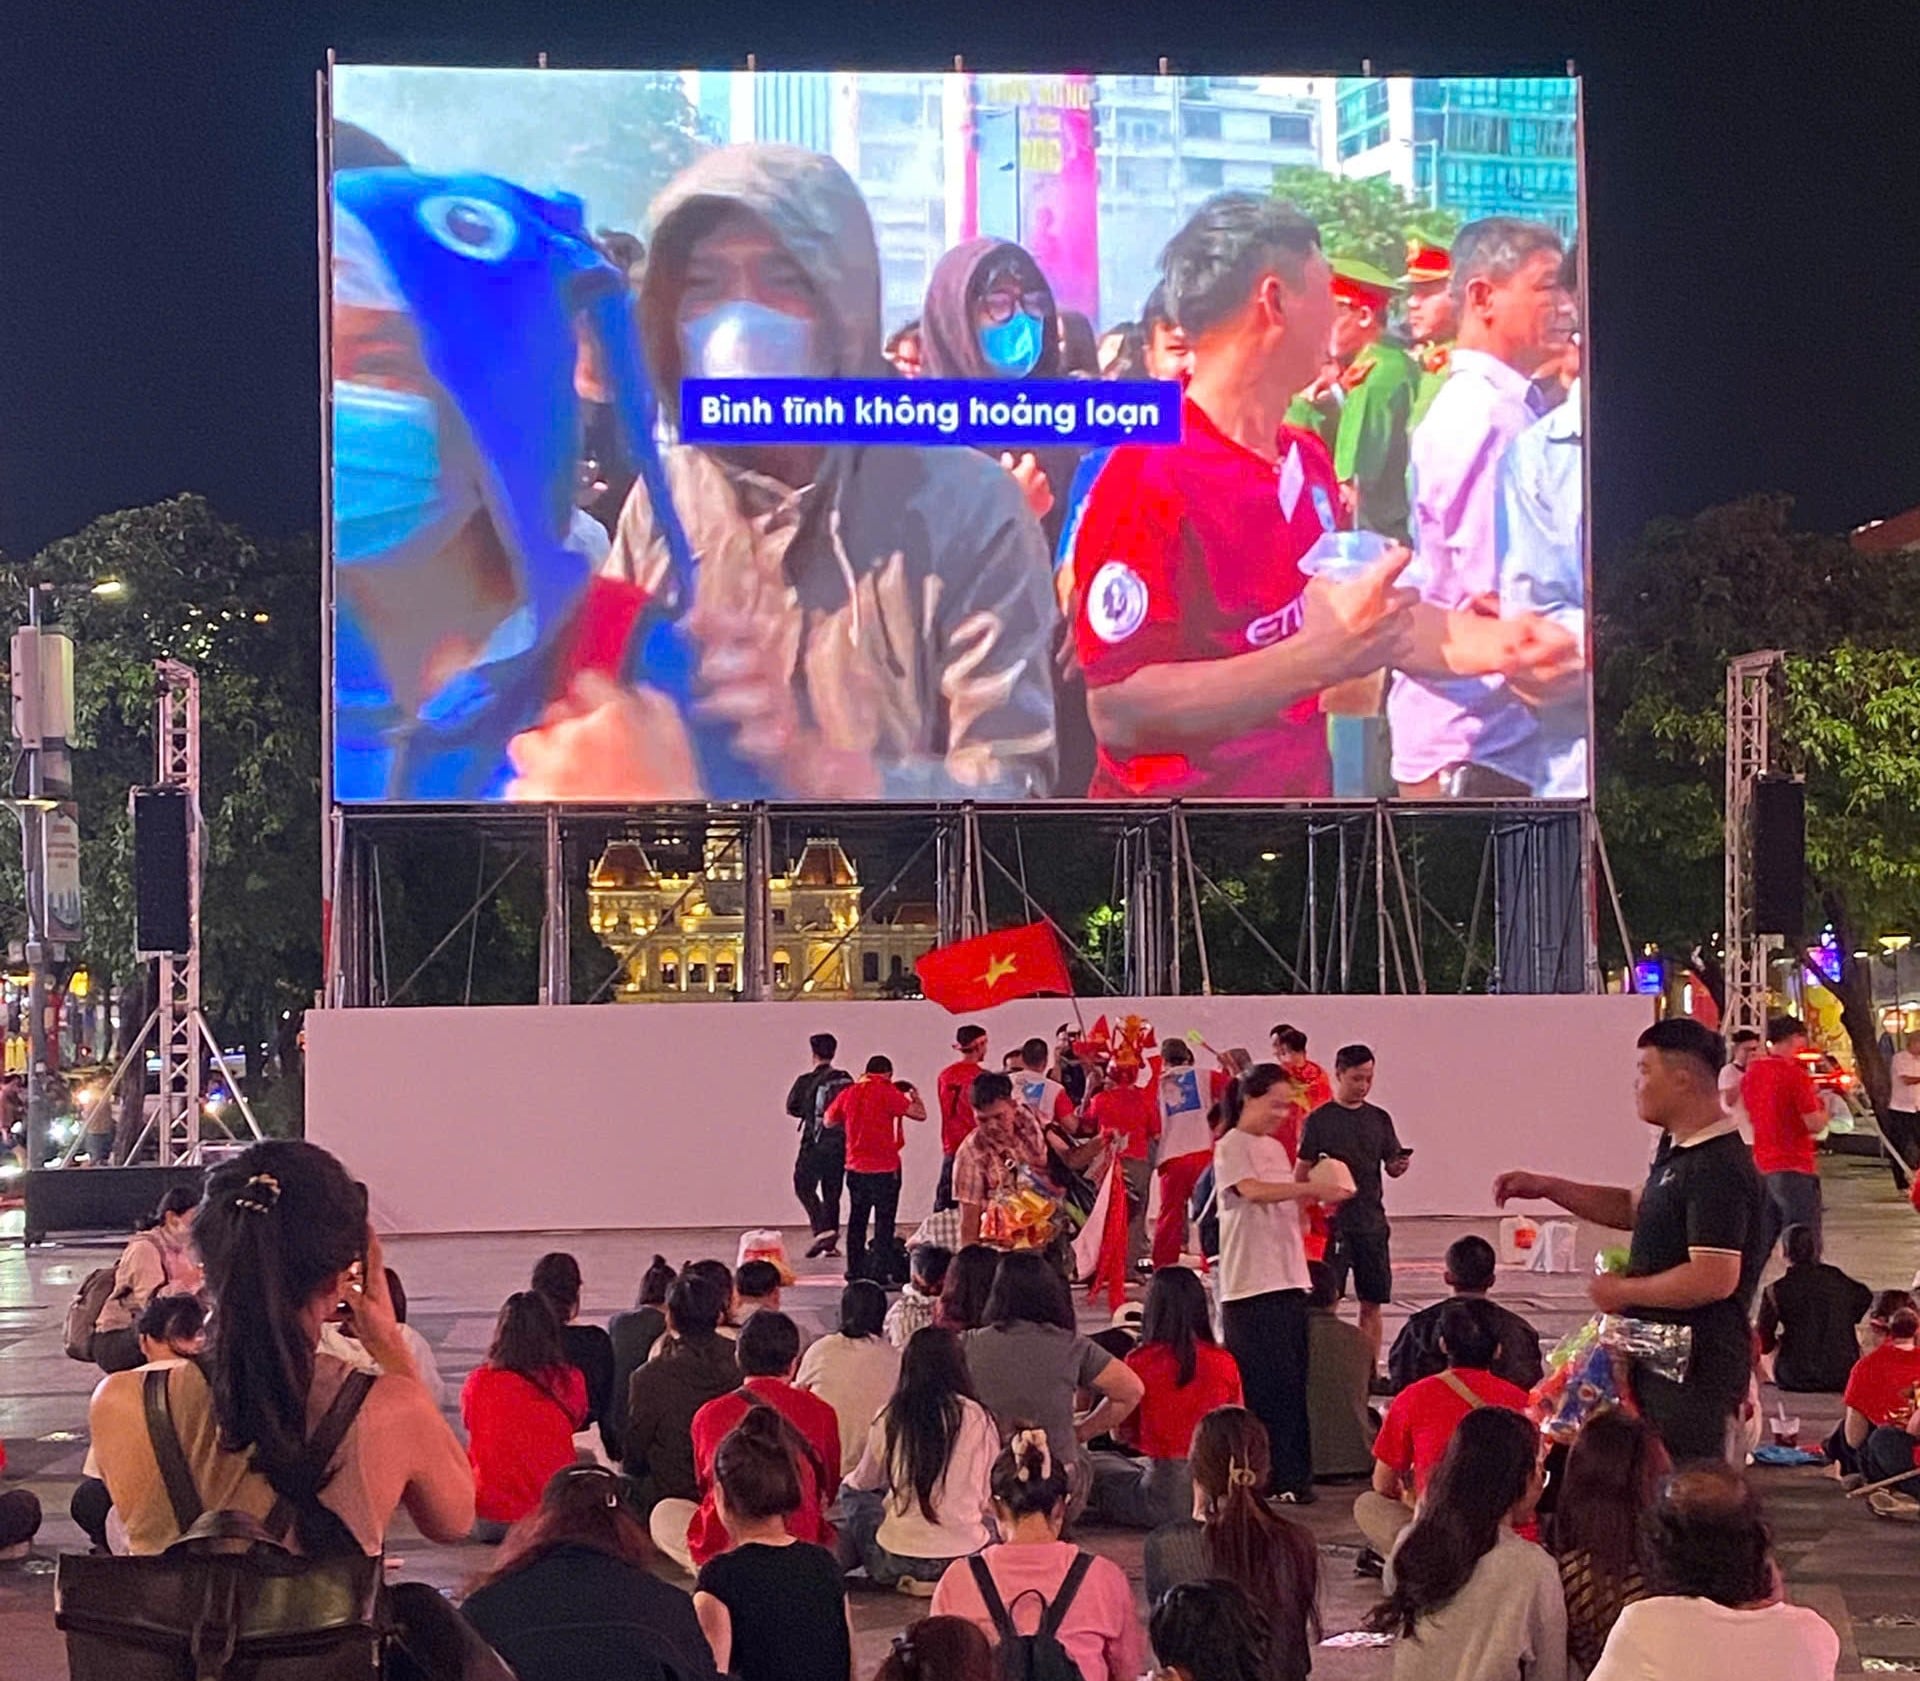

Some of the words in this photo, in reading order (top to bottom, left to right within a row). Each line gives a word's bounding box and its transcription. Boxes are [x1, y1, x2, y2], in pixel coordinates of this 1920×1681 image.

[700, 394, 773, 425] Bình
[782, 396, 845, 425] tĩnh
[855, 395, 960, 433] không
[969, 392, 1077, 434] hoảng
[1086, 397, 1160, 434] loạn
